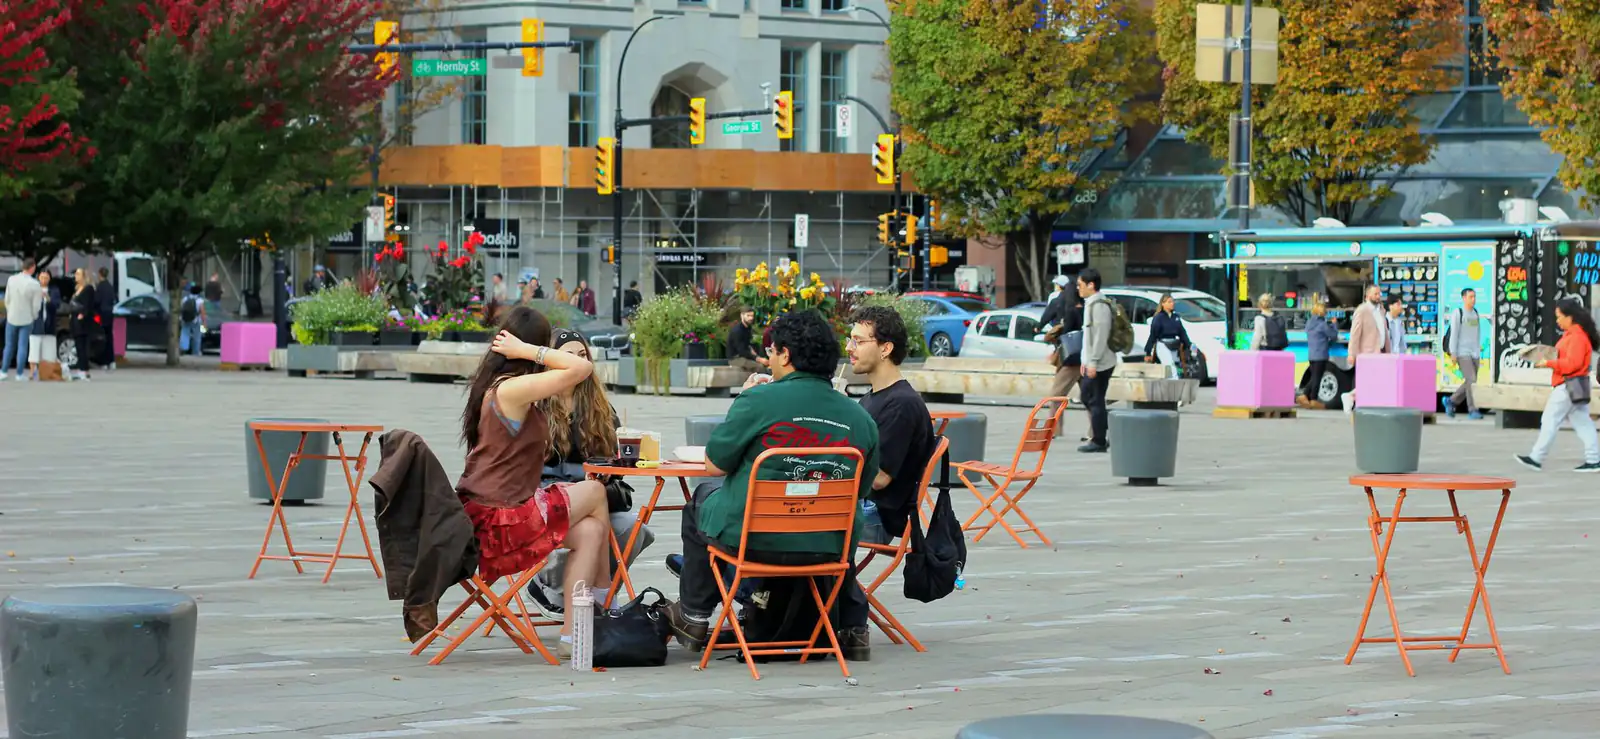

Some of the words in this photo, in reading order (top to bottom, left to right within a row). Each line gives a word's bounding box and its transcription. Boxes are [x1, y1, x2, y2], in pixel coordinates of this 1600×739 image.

[436, 61, 468, 74] Hornby
[470, 61, 480, 72] St
[725, 123, 749, 133] Georgia
[751, 122, 759, 131] St
[1574, 252, 1600, 268] ORD
[1574, 269, 1599, 284] AND
